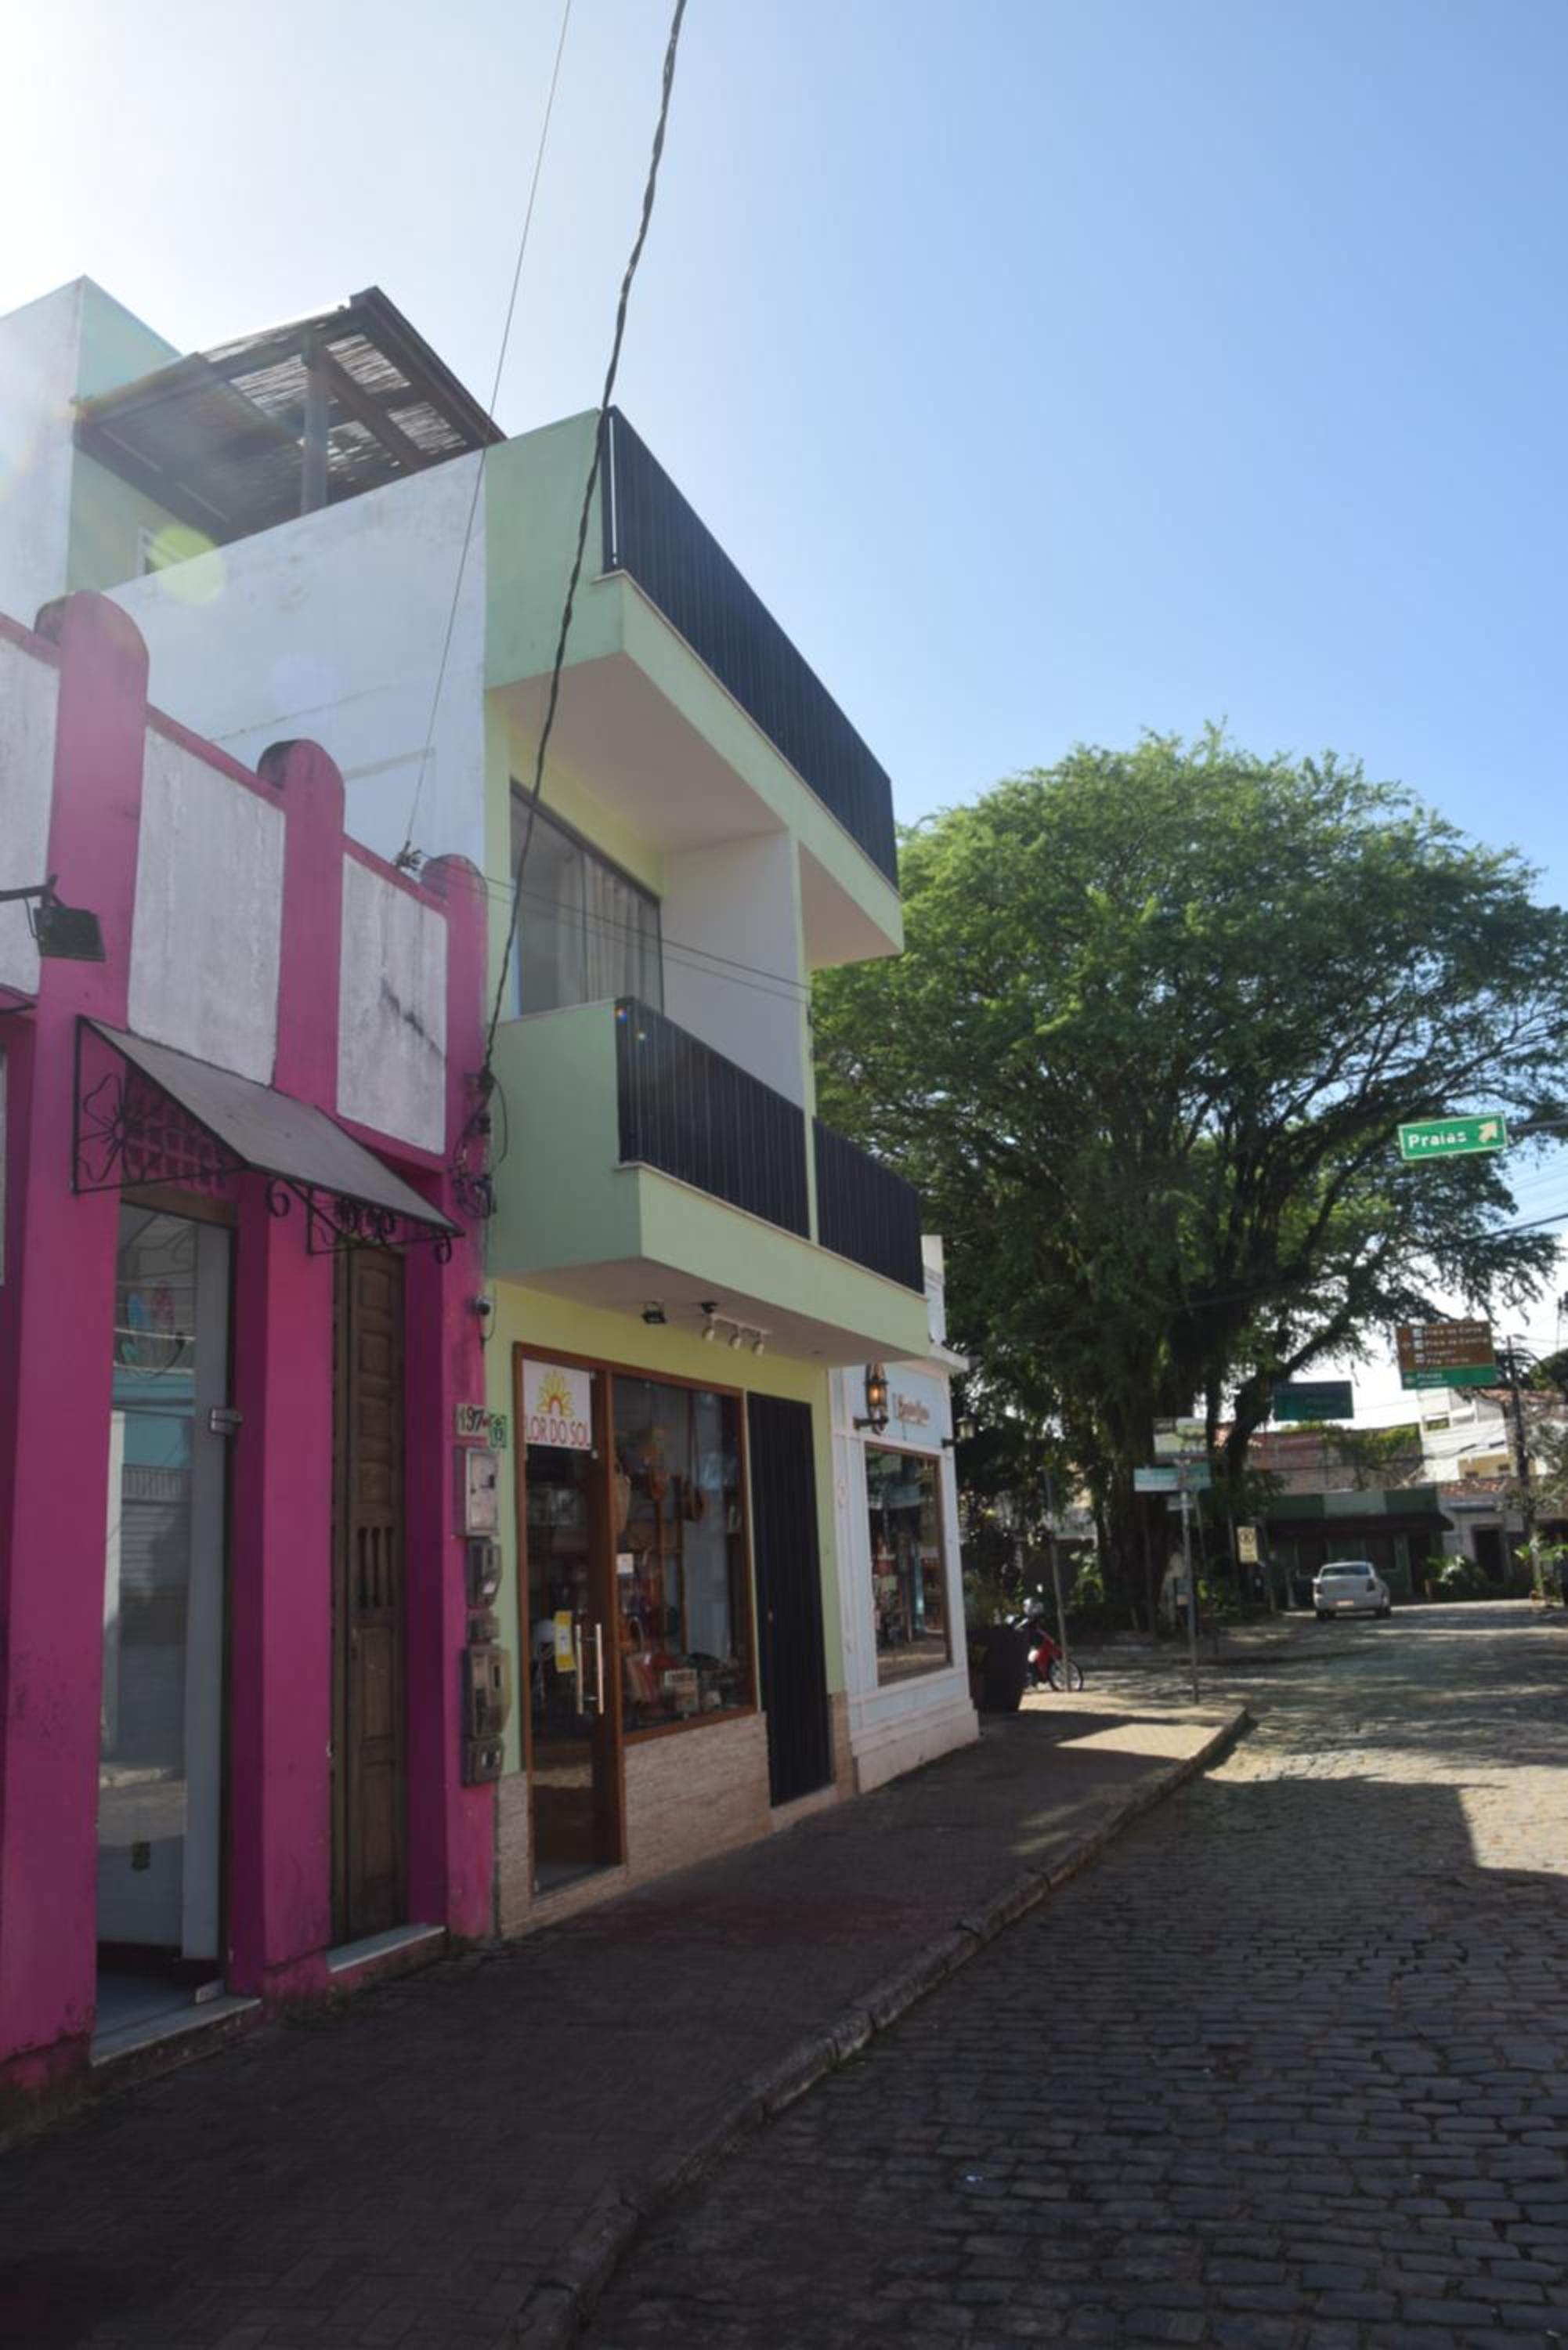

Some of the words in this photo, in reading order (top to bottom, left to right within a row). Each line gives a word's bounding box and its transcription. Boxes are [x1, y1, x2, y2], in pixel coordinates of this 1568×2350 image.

[1408, 1131, 1467, 1148] Praias
[460, 1406, 485, 1432] 197
[551, 1418, 567, 1444] DO
[570, 1421, 590, 1447] SOL
